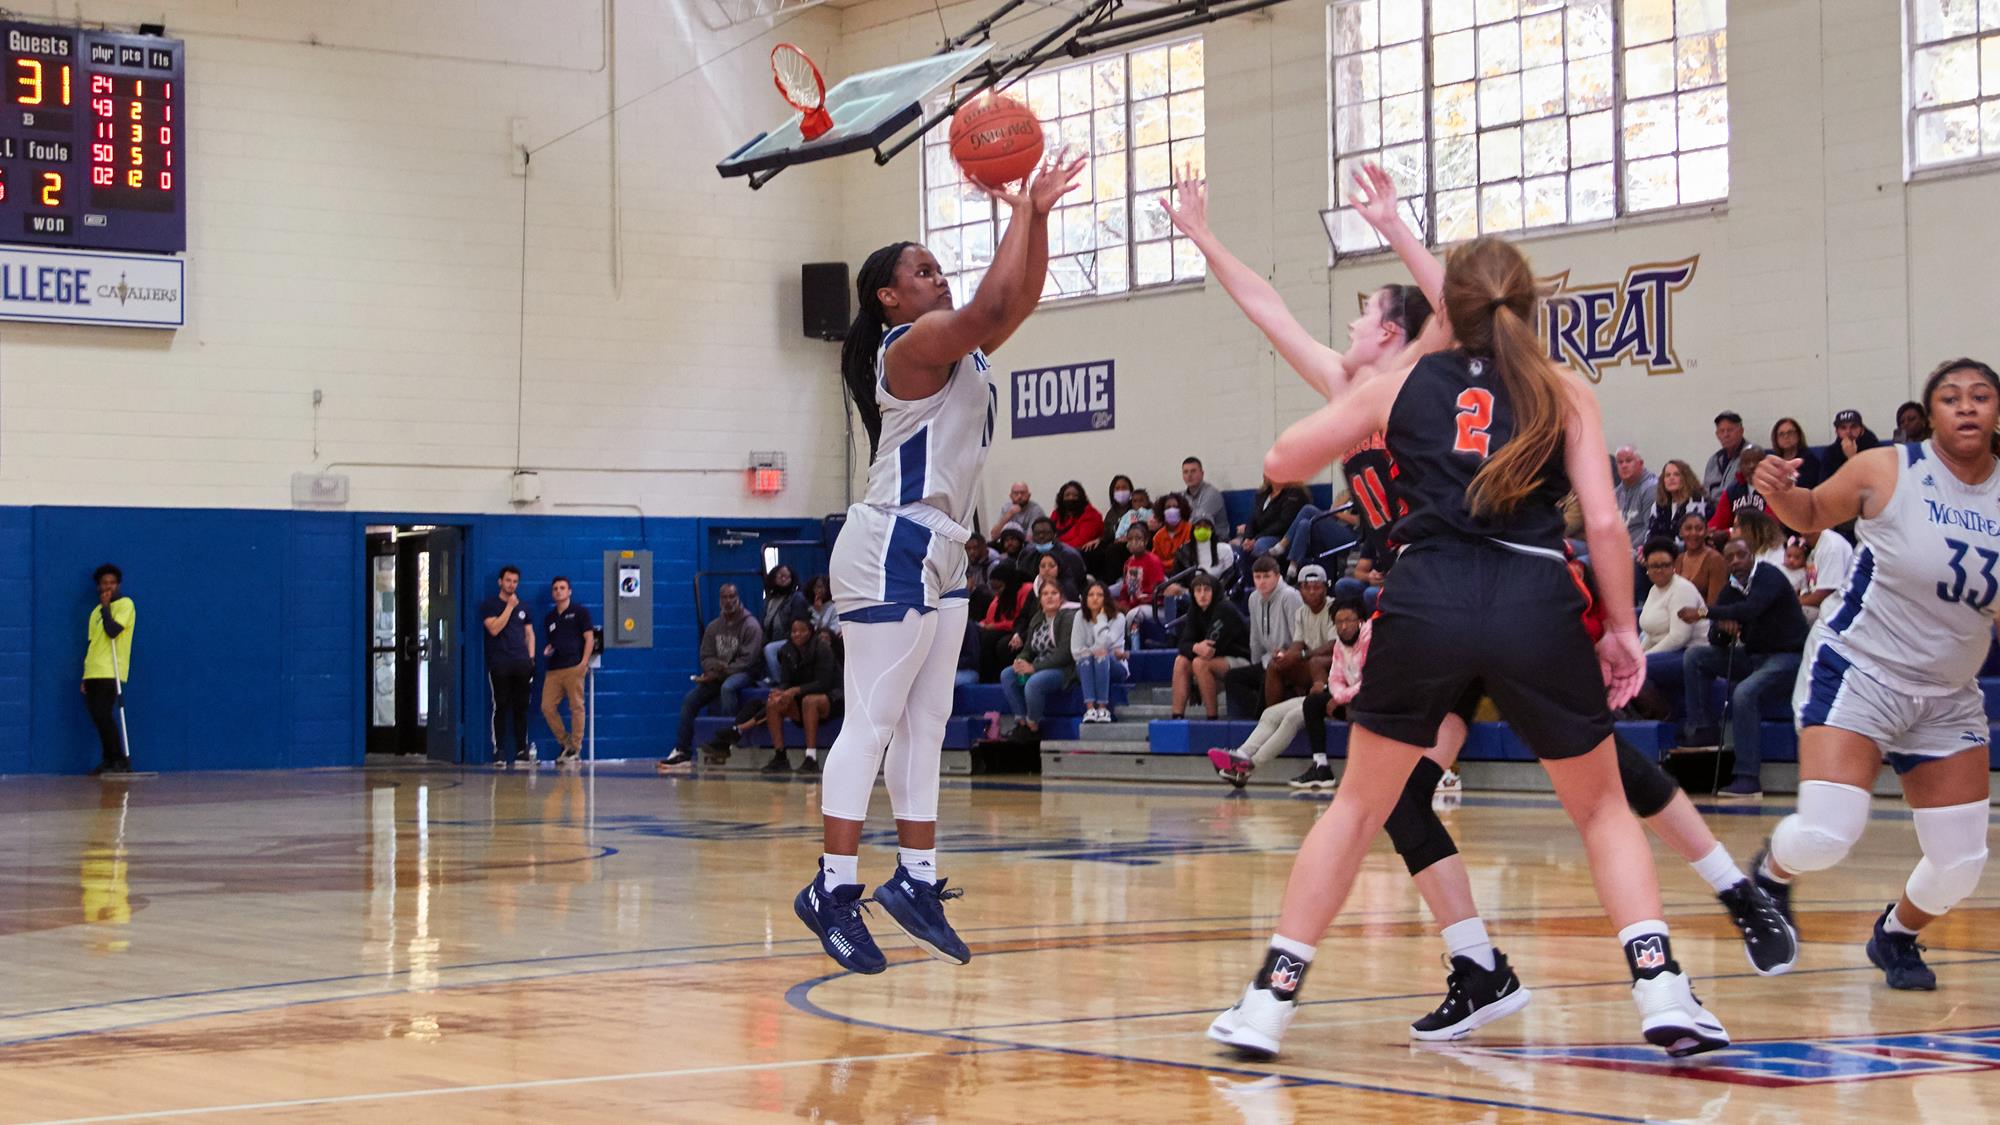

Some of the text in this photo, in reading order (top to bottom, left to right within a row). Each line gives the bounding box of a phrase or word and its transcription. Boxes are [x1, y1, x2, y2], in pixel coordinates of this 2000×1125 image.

[10, 31, 68, 56] Guests
[92, 44, 168, 66] plyr pts fls
[18, 59, 70, 105] 31
[92, 75, 113, 94] 24
[135, 80, 142, 97] 1
[23, 113, 34, 126] B
[92, 98, 113, 118] 43
[130, 101, 142, 120] 2
[99, 122, 170, 144] 11 3 0
[970, 120, 1034, 151] SPALDING
[93, 144, 113, 163] 50
[131, 146, 143, 165] 5
[42, 172, 62, 206] 2
[93, 166, 171, 190] 02 12 0
[33, 217, 65, 232] won
[3, 264, 91, 305] LLEGE
[1536, 255, 1699, 384] REAT
[1017, 365, 1109, 419] HOME
[1454, 387, 1494, 457] 2
[1352, 466, 1392, 530] 11
[1936, 537, 1999, 609] 33
